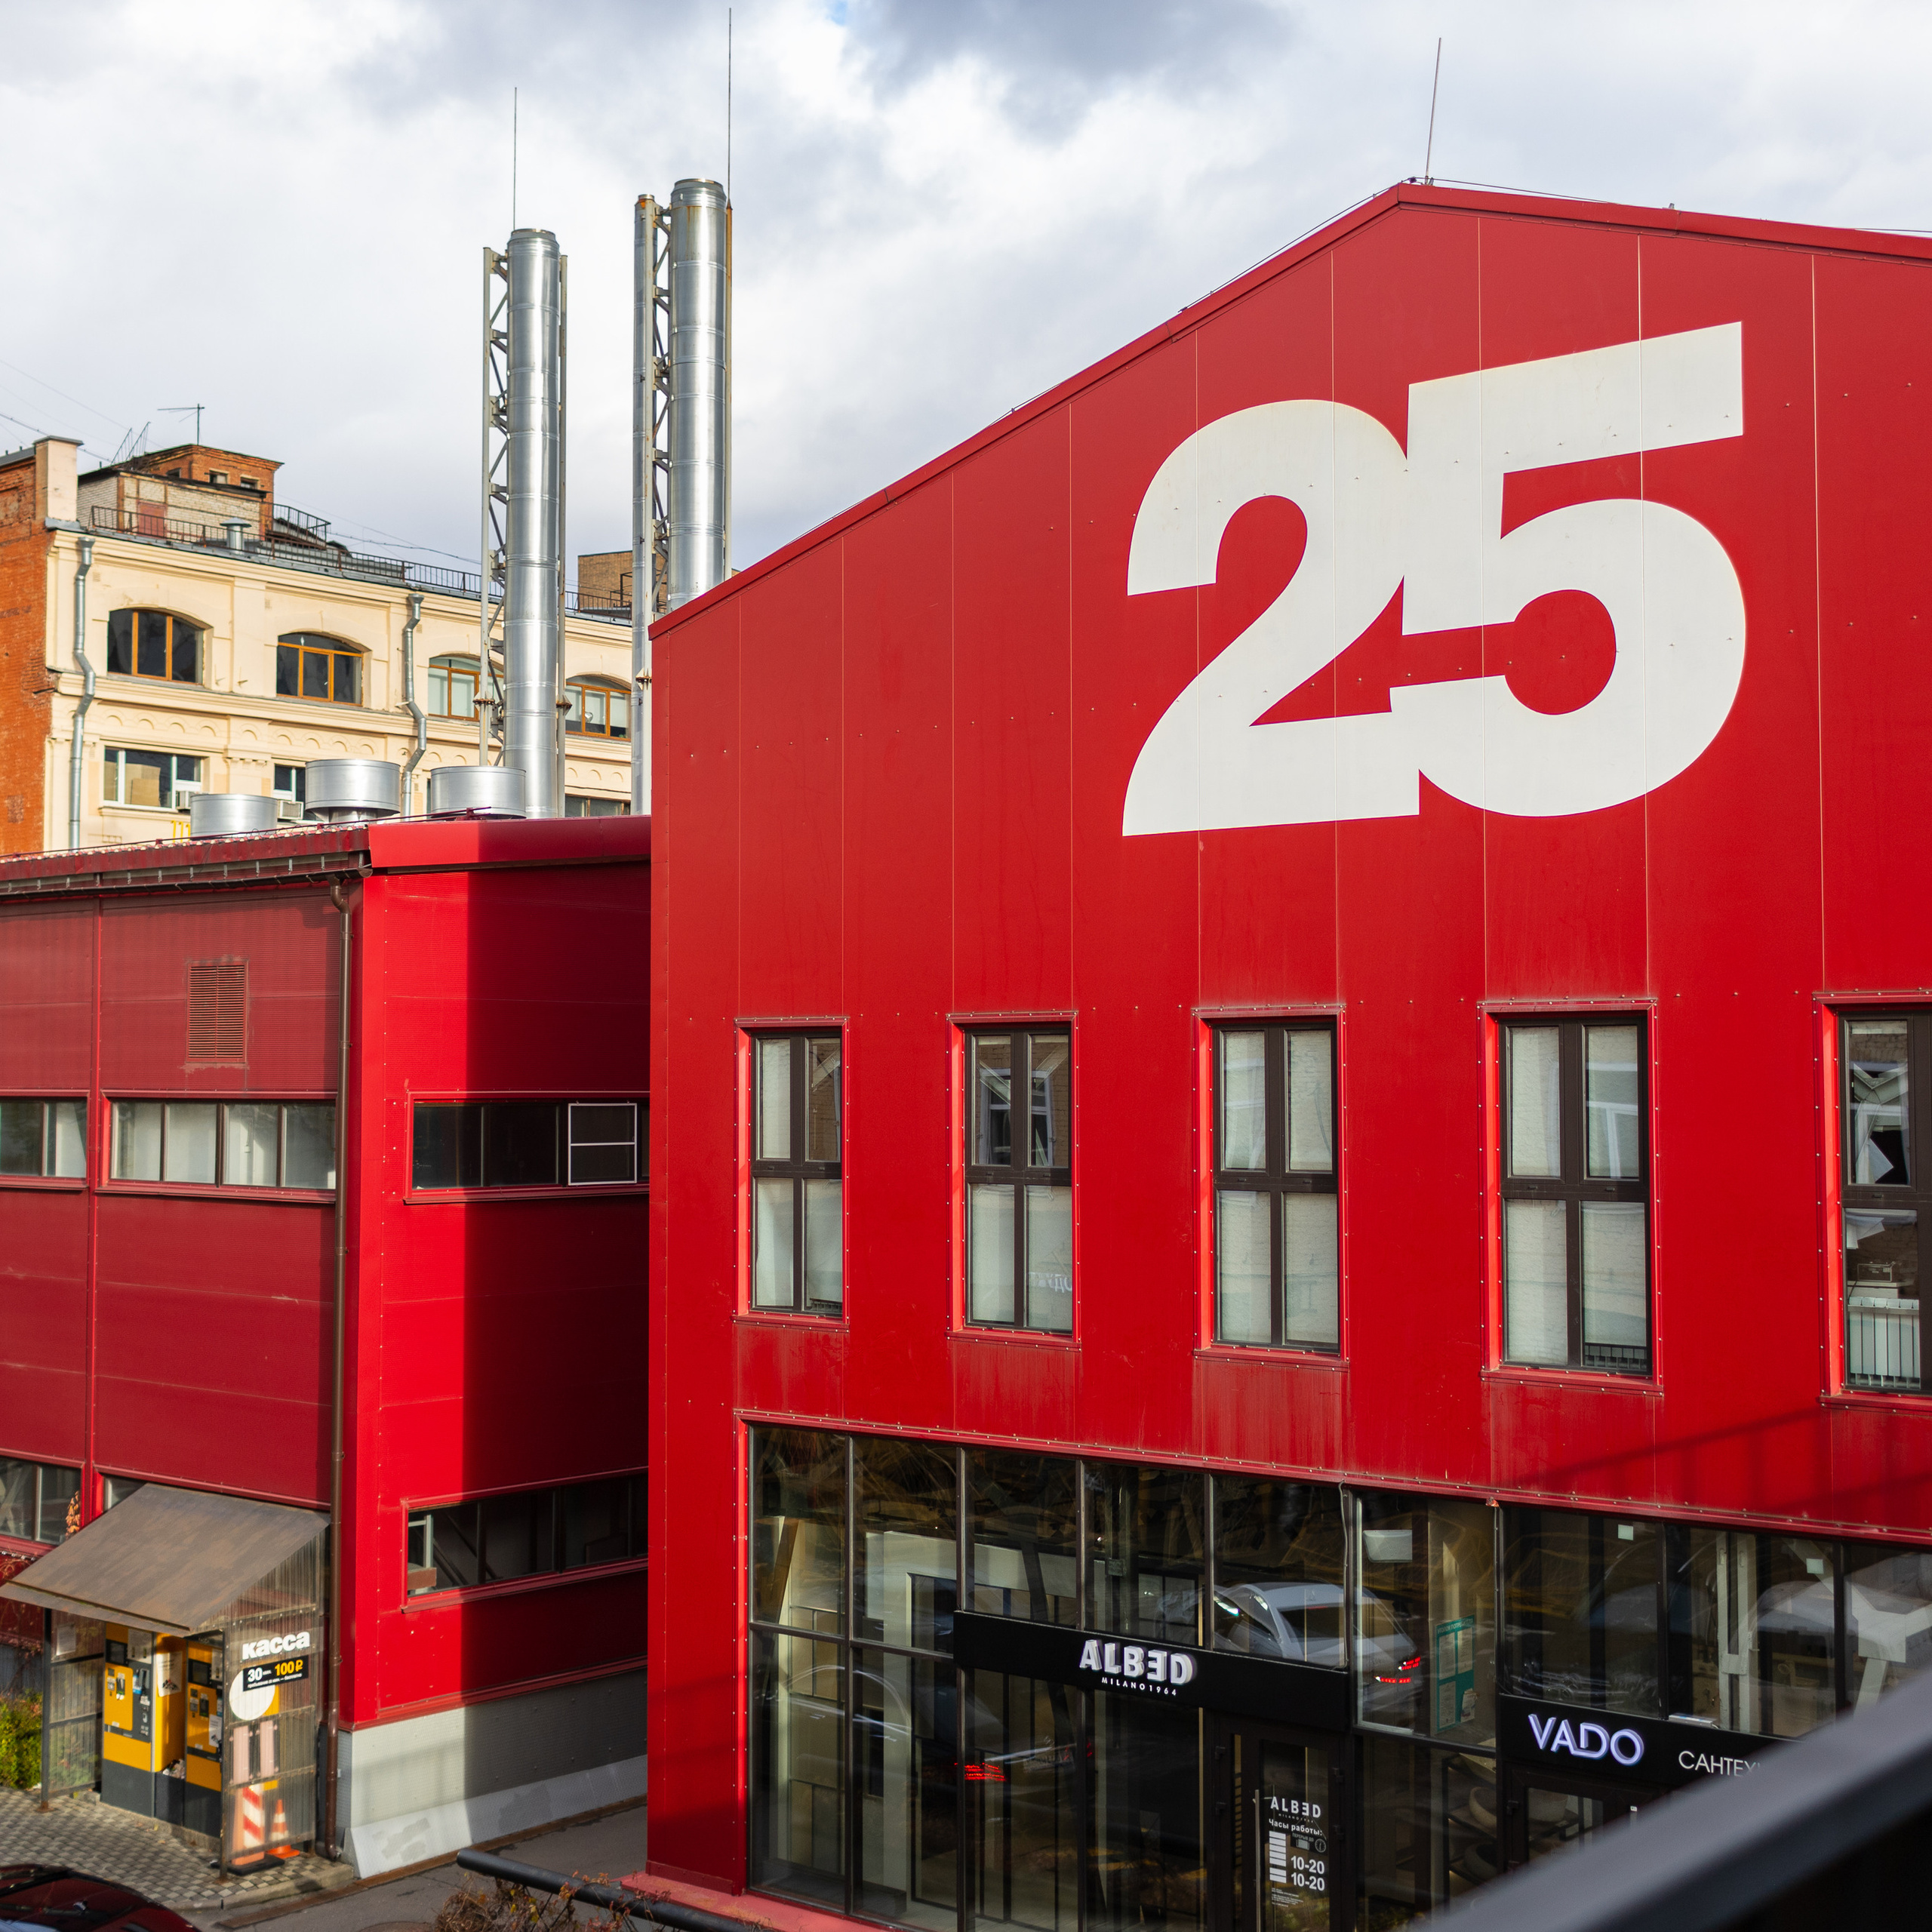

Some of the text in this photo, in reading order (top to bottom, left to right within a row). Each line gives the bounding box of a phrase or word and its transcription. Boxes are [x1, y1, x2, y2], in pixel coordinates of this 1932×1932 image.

[1122, 321, 1746, 837] 25
[242, 1631, 310, 1660] касса
[248, 1667, 263, 1682] 30
[1527, 1713, 1644, 1766] VADO
[1269, 1818, 1322, 1836] Часы работы:
[1291, 1855, 1325, 1875] 10-20
[1291, 1872, 1325, 1891] 10-20
